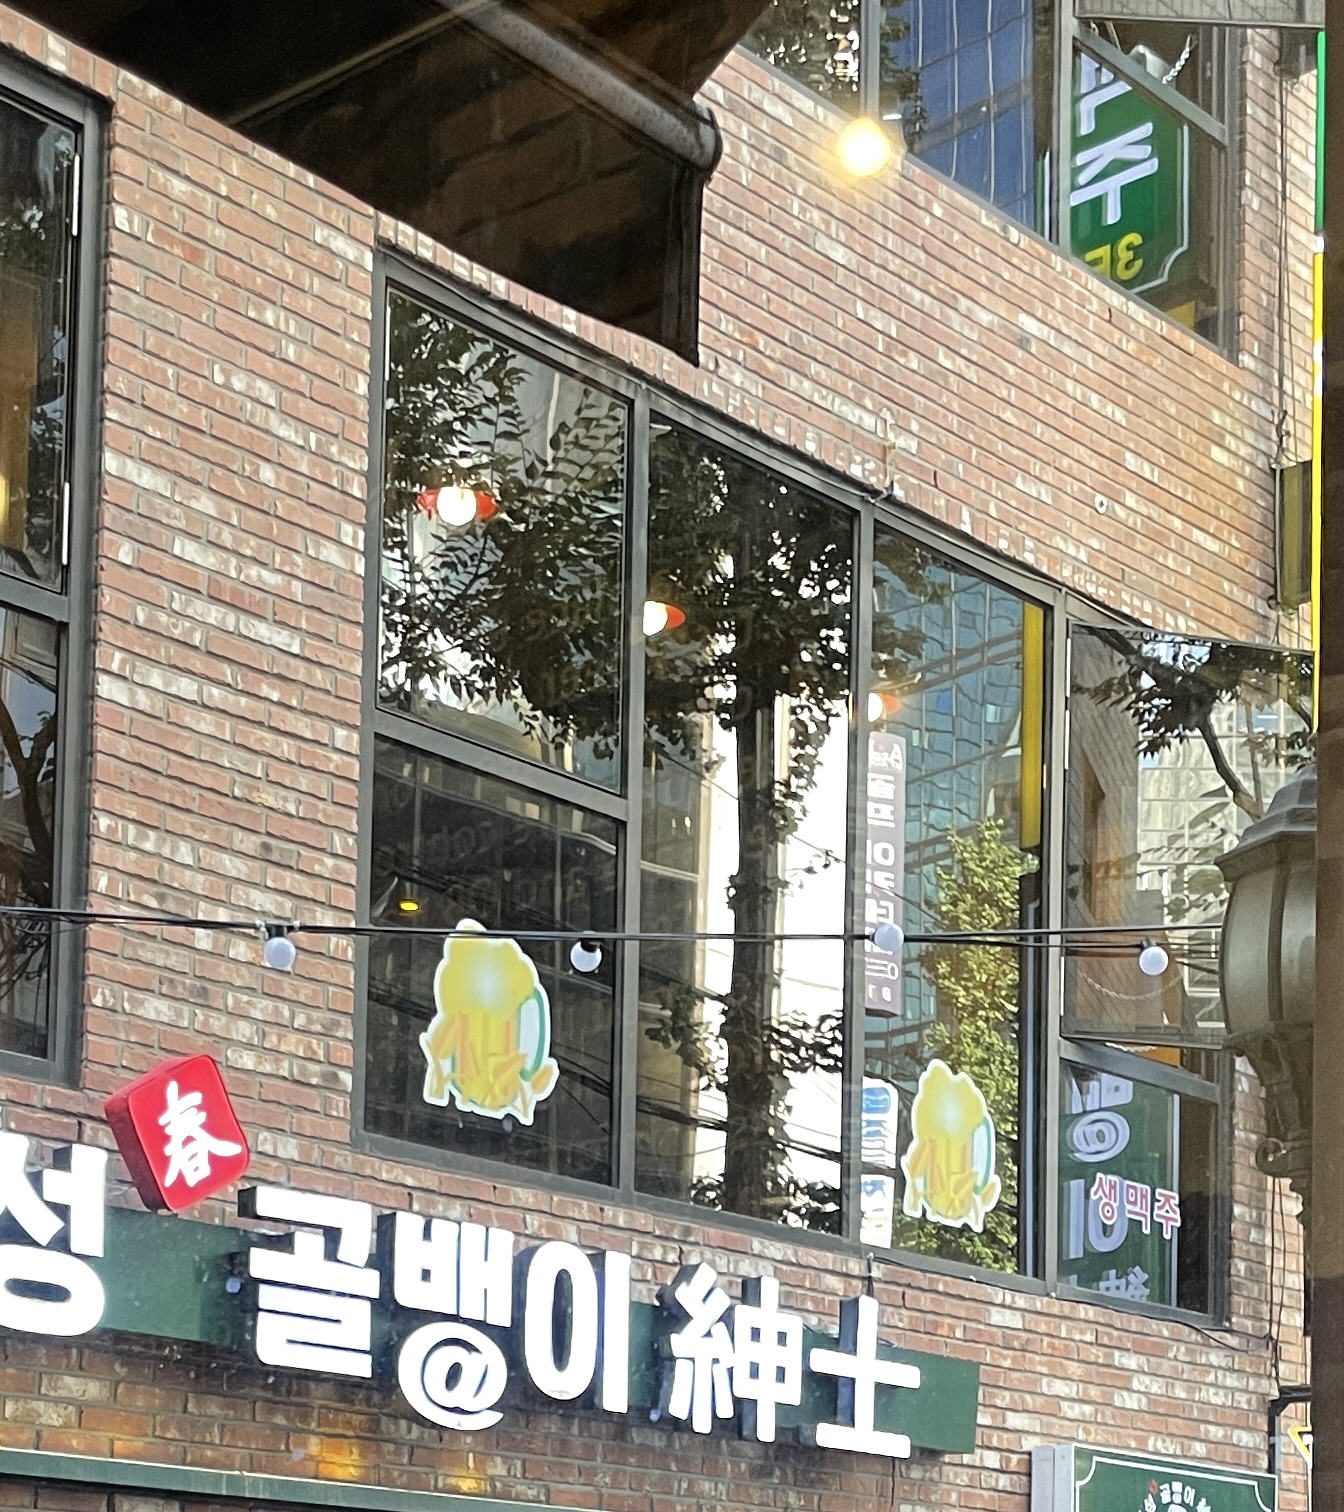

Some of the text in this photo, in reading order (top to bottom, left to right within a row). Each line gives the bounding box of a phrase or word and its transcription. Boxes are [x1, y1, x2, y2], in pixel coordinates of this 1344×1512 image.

[158, 1080, 243, 1187] 春
[666, 1262, 922, 1460] 紳士
[1091, 1172, 1181, 1239] 생맥주
